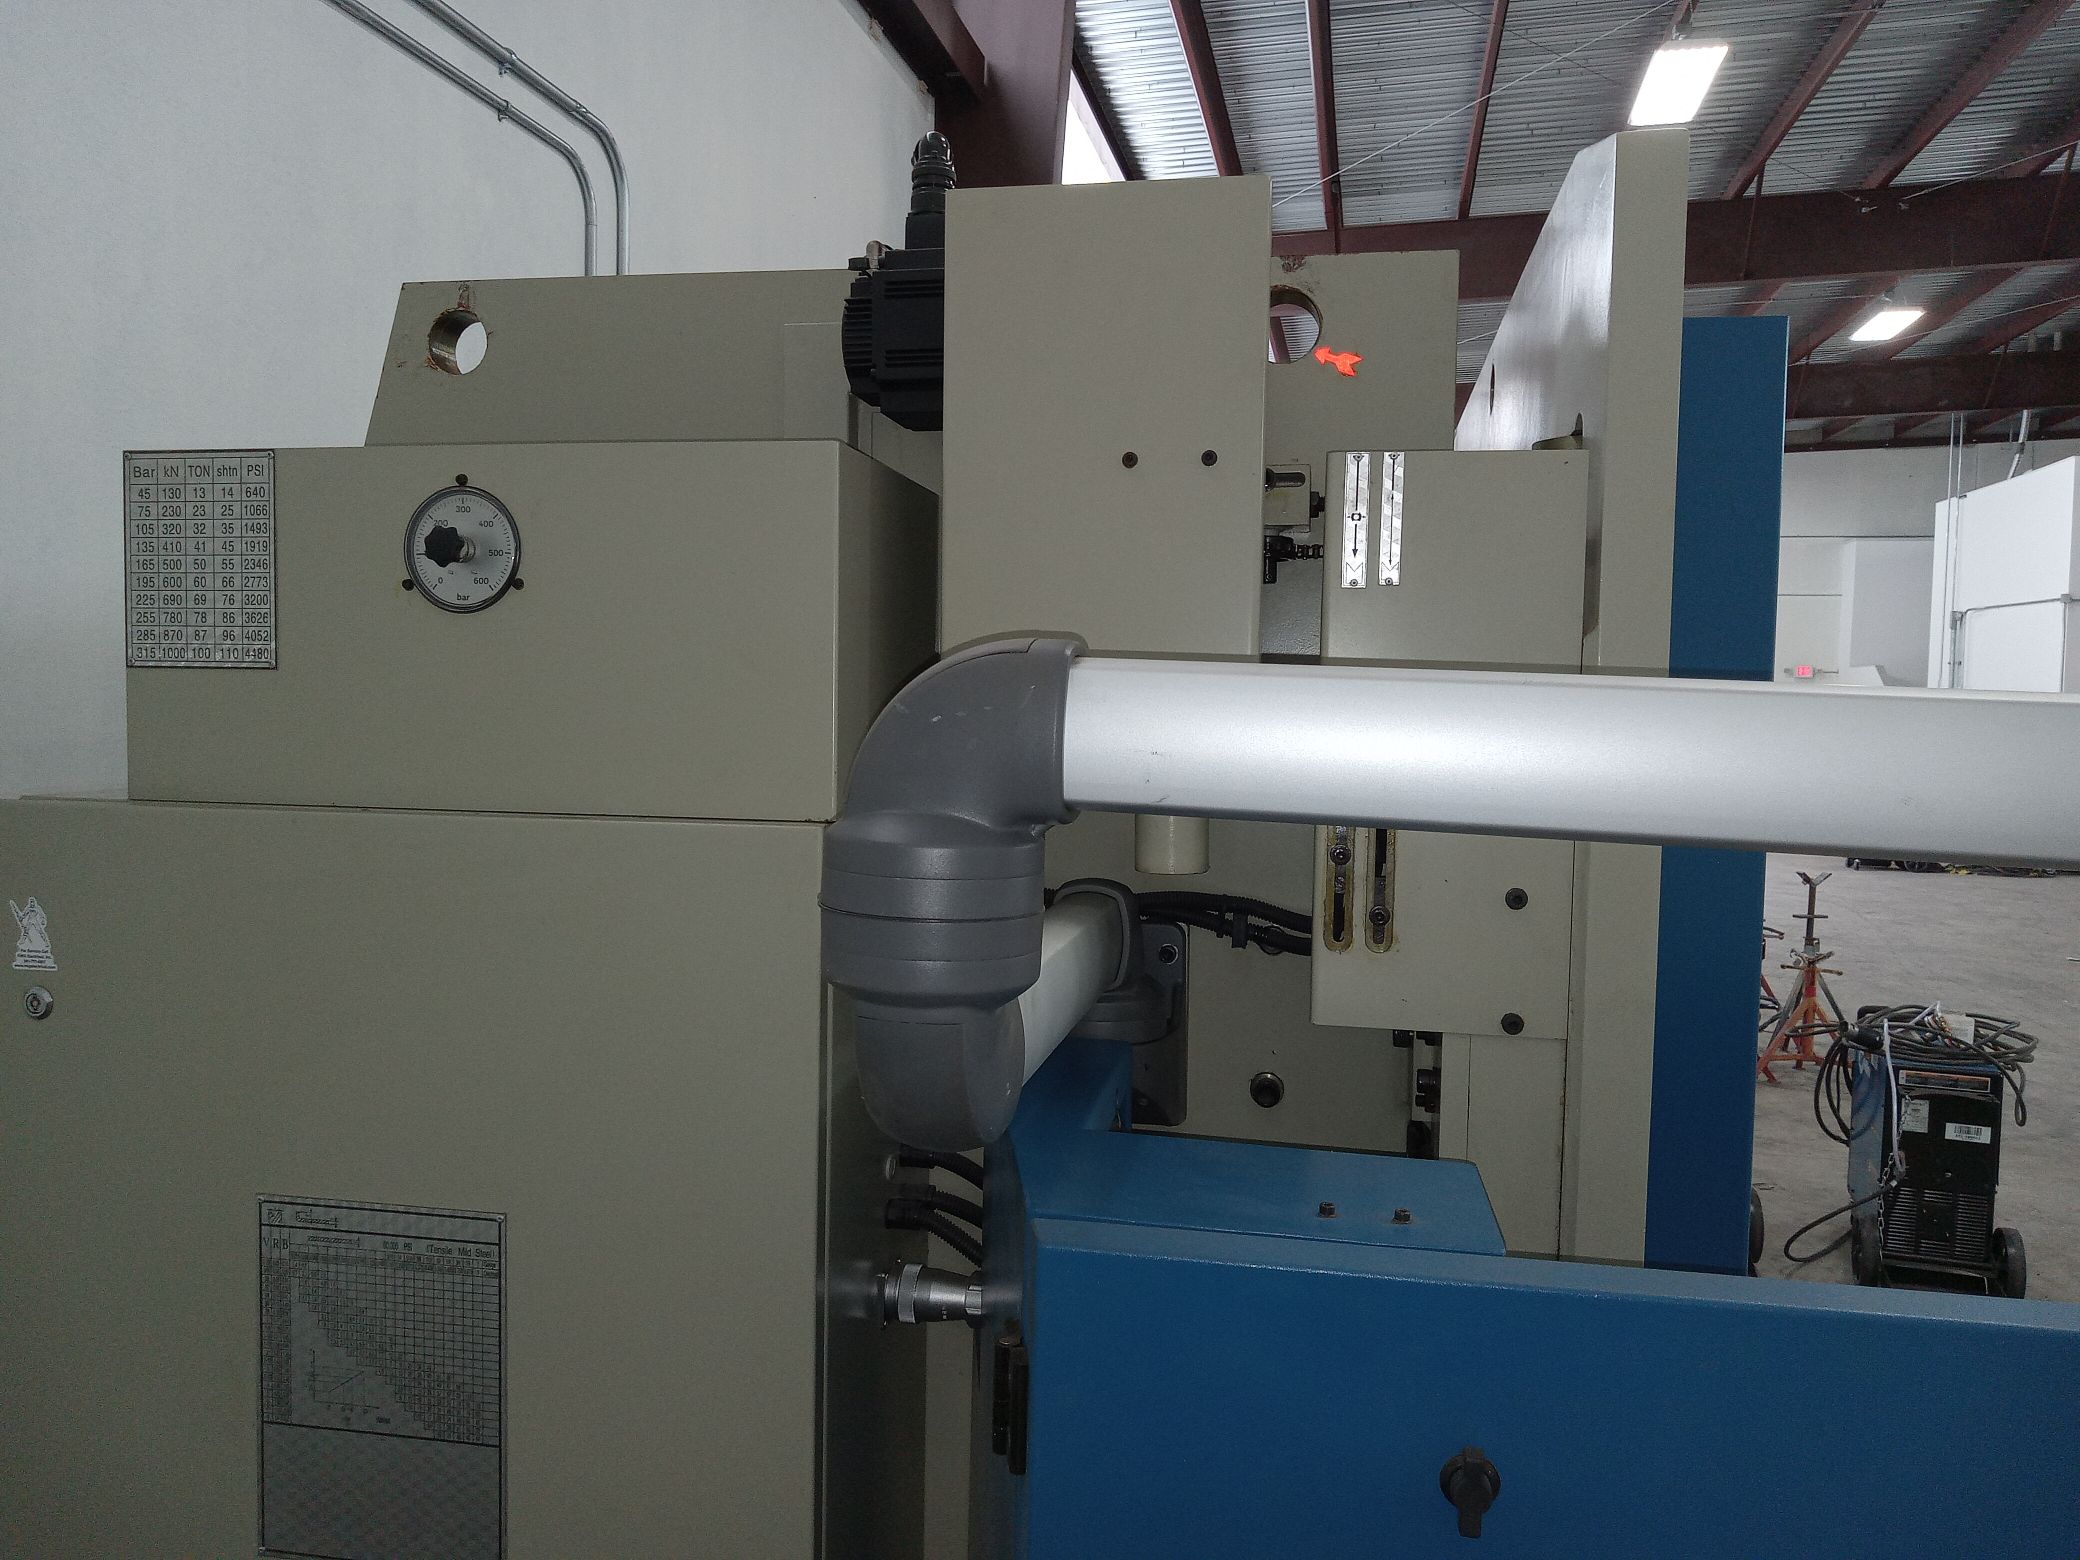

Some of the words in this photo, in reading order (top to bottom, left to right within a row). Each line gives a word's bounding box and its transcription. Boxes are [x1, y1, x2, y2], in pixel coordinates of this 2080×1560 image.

[133, 466, 155, 478] Bar
[163, 465, 179, 478] kN
[188, 465, 210, 478] TON
[217, 464, 238, 477] shtn
[247, 464, 264, 477] PSI
[138, 488, 151, 500] 45
[162, 487, 182, 500] 130
[193, 487, 206, 499] 13
[221, 486, 235, 499] 14
[245, 486, 266, 498] 640
[137, 505, 151, 518] 75
[161, 505, 182, 518] 230
[192, 504, 206, 517] 23
[221, 504, 234, 517] 25
[244, 504, 268, 516] 1066
[455, 505, 471, 513] 300
[136, 523, 154, 535] 105
[162, 523, 182, 535] 320
[193, 523, 206, 535] 32
[221, 522, 235, 535] 35
[244, 522, 268, 534] 1493
[478, 520, 494, 528] 400
[136, 541, 155, 553] 135
[162, 541, 182, 553] 410
[193, 540, 206, 553] 41
[221, 540, 235, 553] 45
[244, 540, 268, 553] 1919
[488, 549, 504, 557] 500
[136, 559, 155, 570] 165
[162, 559, 182, 570] 500
[193, 559, 207, 570] 50
[221, 558, 235, 570] 55
[243, 558, 269, 570] 2346
[136, 576, 155, 588] 195
[162, 576, 183, 588] 600
[193, 576, 207, 588] 60
[221, 576, 235, 588] 66
[243, 576, 269, 588] 2773
[473, 577, 489, 585] 600
[136, 594, 156, 606] 225
[163, 594, 183, 606] 690
[193, 594, 207, 606] 69
[222, 594, 235, 606] 76
[244, 594, 269, 606] 3200
[456, 593, 470, 601] bar
[136, 611, 156, 623] 255
[163, 611, 183, 623] 780
[194, 611, 207, 623] 78
[222, 611, 236, 623] 86
[244, 611, 269, 623] 3626
[136, 629, 156, 641] 285
[163, 629, 183, 641] 870
[194, 629, 208, 641] 87
[222, 629, 236, 641] 96
[244, 629, 269, 641] 4052
[136, 647, 156, 659] 315
[162, 647, 186, 659] 1000
[192, 647, 211, 659] 100
[220, 647, 239, 659] 110
